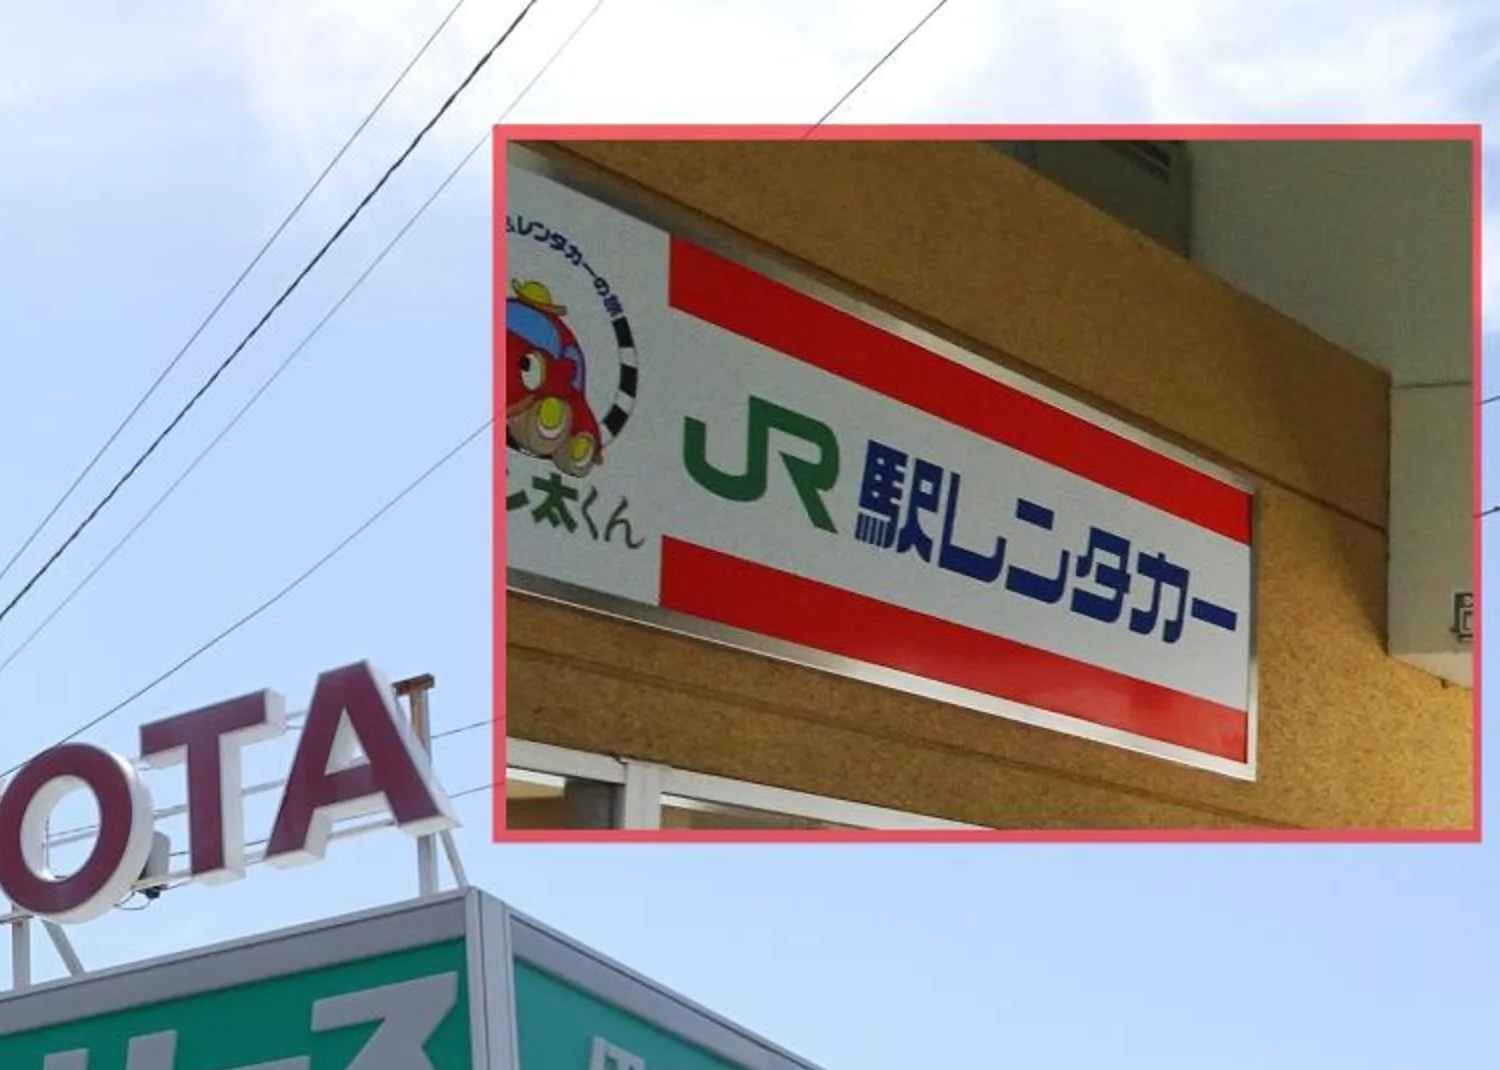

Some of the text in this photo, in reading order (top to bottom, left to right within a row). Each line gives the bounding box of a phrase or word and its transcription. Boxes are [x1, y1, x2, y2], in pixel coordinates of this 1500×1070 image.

[683, 395, 1238, 644] JR 駅レンタカー
